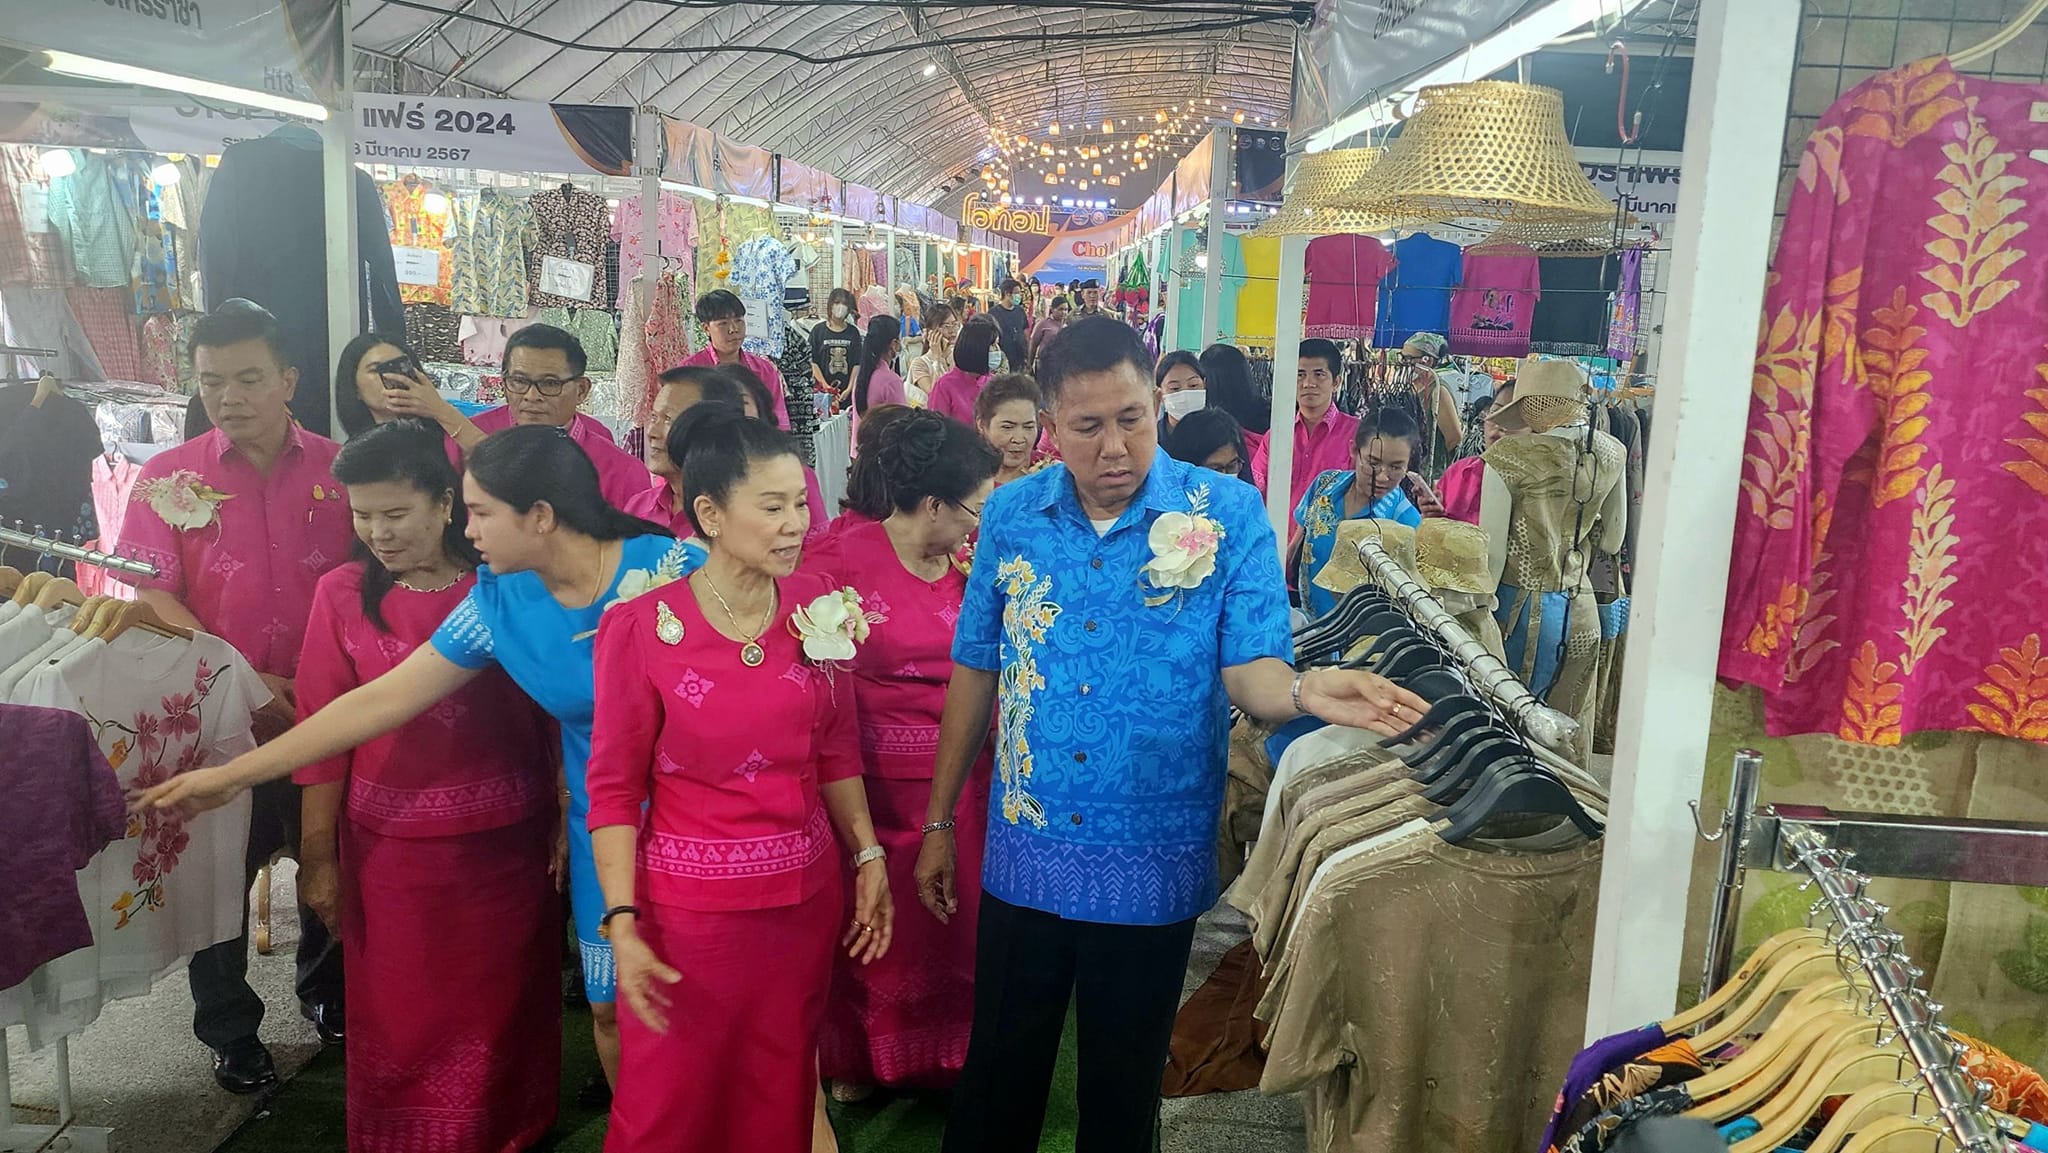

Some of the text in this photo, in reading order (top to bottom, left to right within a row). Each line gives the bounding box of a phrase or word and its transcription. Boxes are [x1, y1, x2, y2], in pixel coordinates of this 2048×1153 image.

[263, 66, 295, 93] H13
[363, 101, 516, 135] แฟร์ 2024
[365, 140, 421, 159] มีนาคม
[426, 147, 471, 161] 2567
[963, 192, 1050, 235] โอทอป
